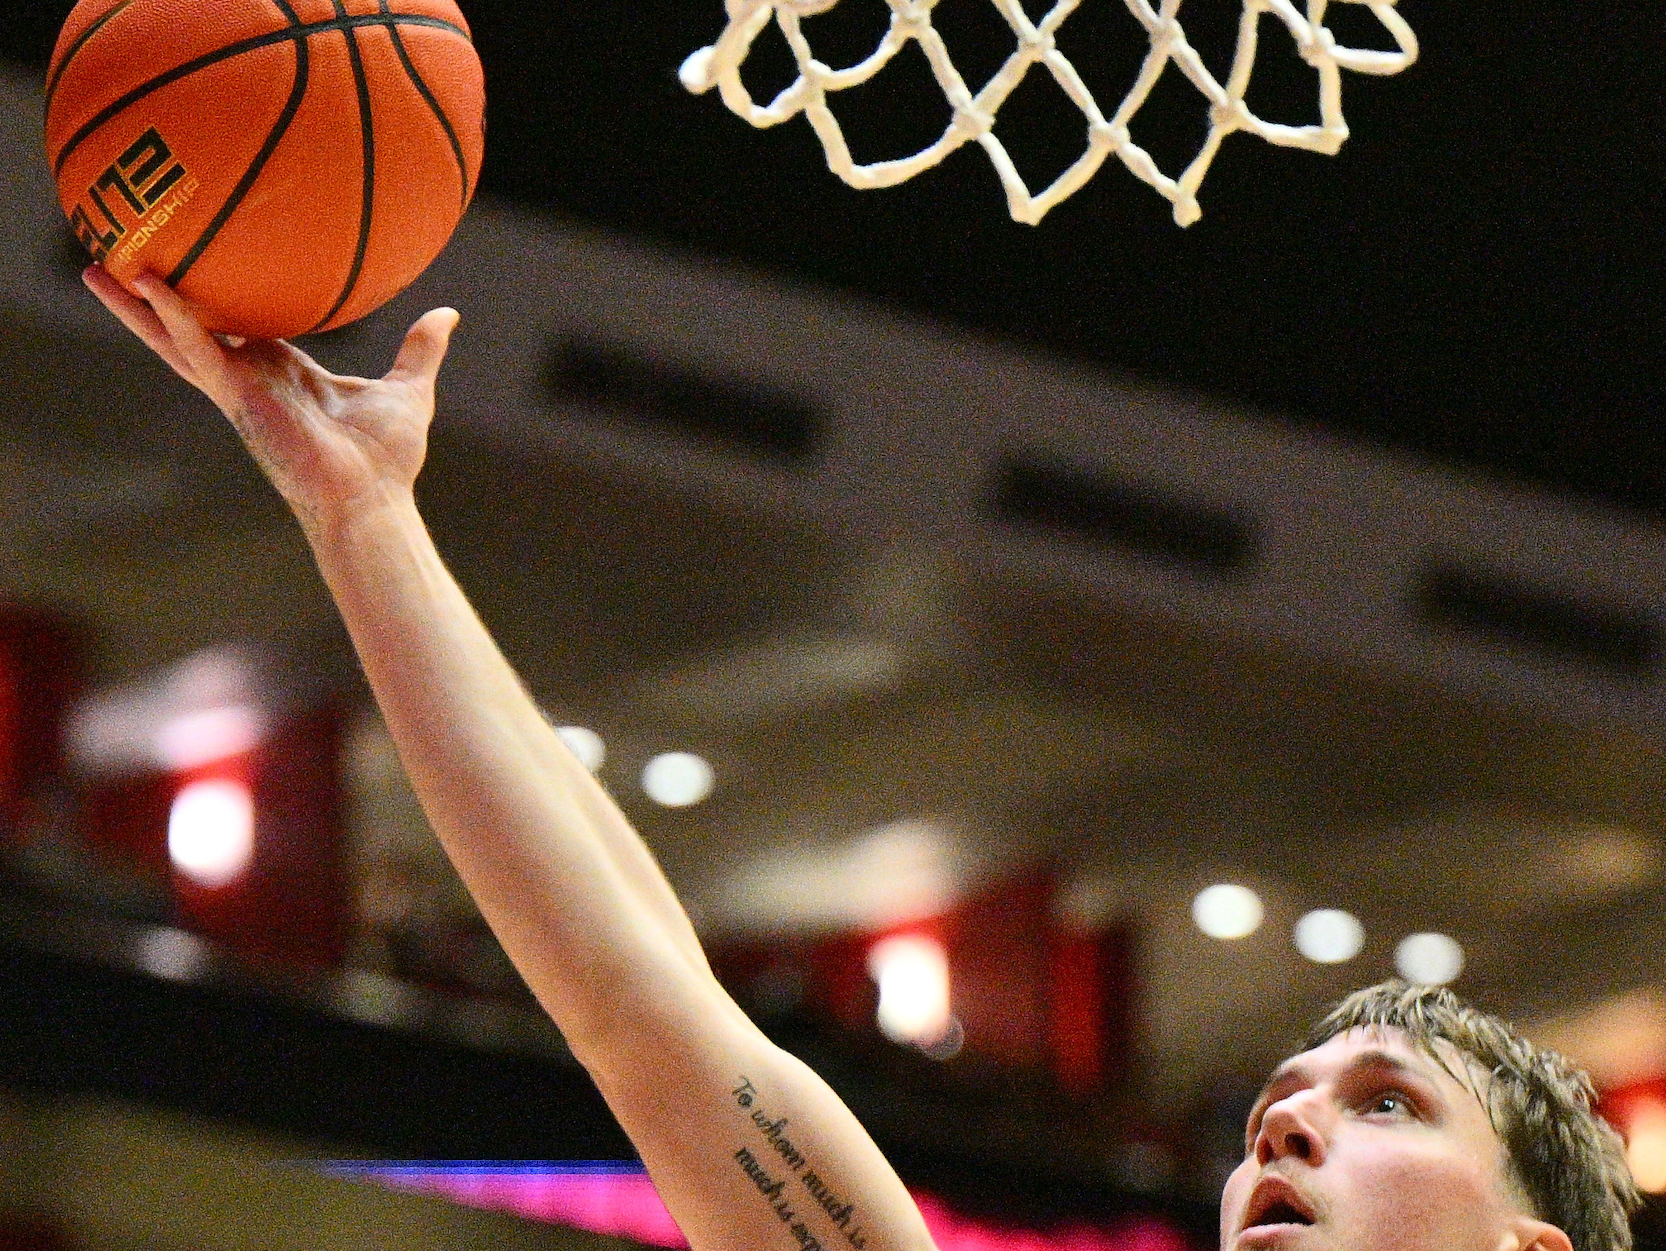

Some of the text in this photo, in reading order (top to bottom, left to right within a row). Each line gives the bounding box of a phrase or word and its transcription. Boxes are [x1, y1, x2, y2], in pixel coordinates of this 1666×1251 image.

[733, 1075, 757, 1108] To
[751, 1109, 805, 1170] whom
[802, 1170, 854, 1229] much
[847, 1227, 866, 1250] is
[735, 1146, 786, 1198] much
[773, 1200, 795, 1223] is
